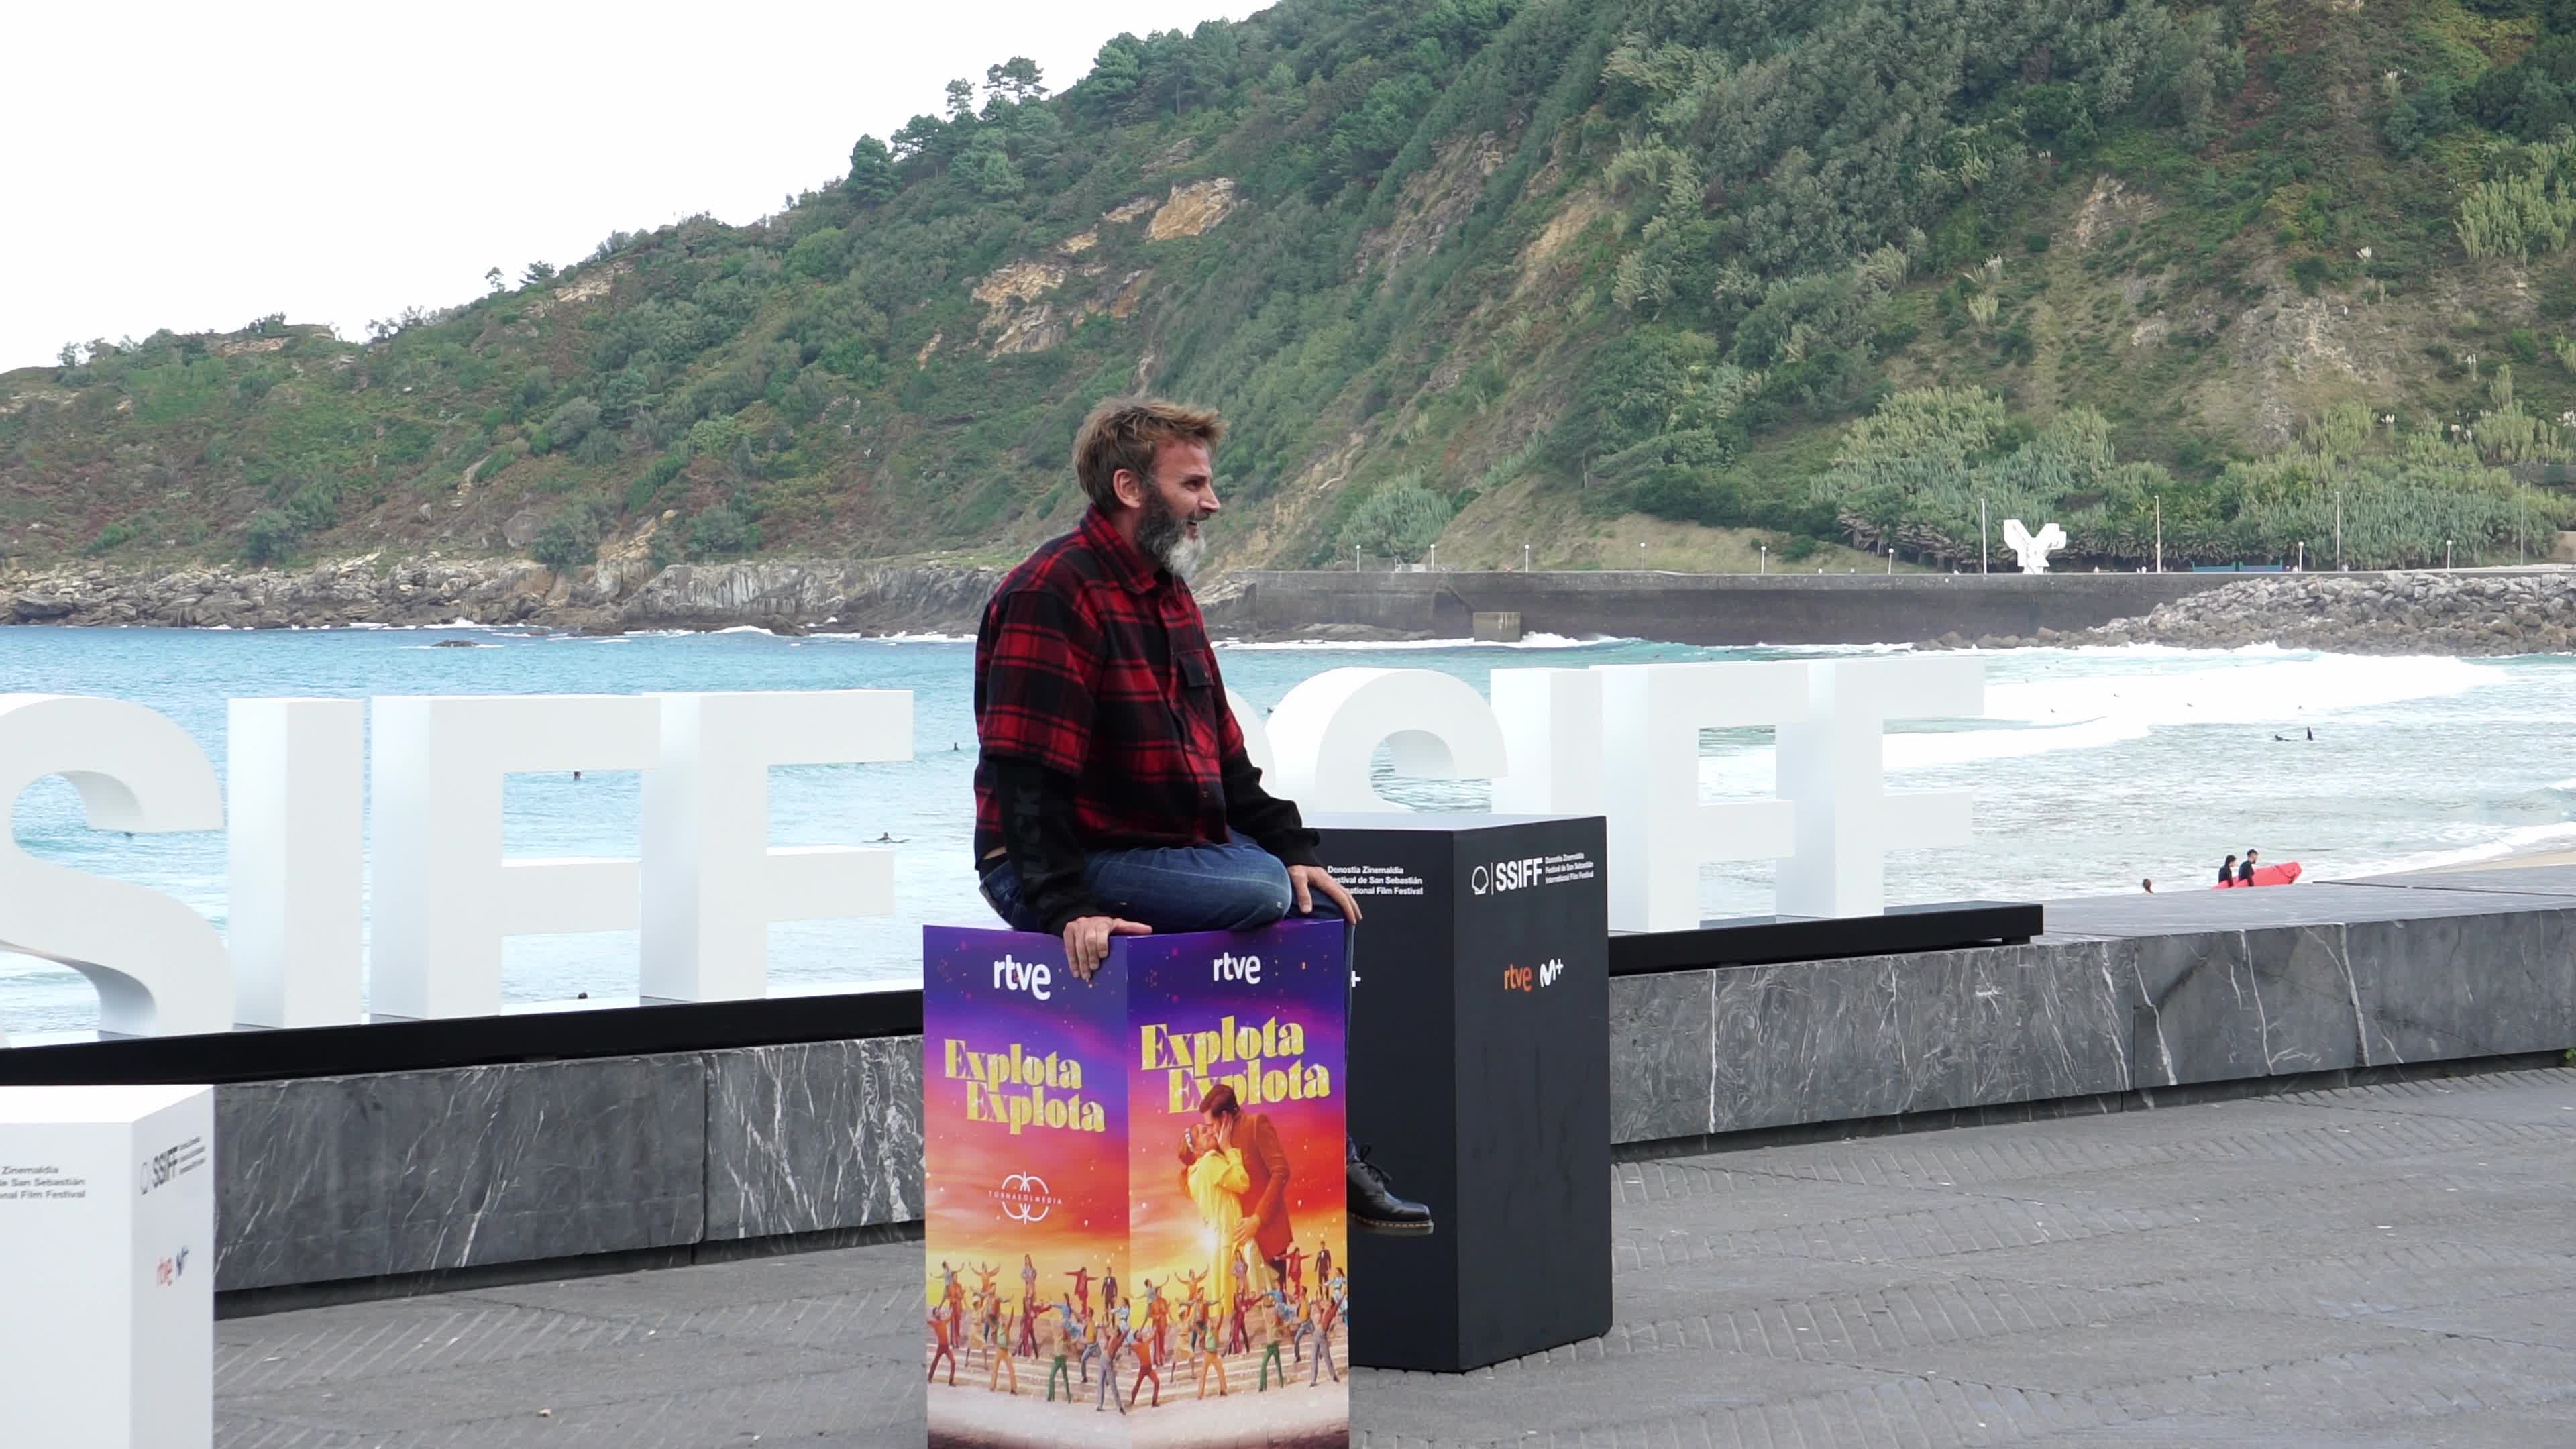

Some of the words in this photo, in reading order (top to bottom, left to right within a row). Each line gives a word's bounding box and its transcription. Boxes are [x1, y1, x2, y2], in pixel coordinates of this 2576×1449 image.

[1327, 865, 1361, 874] Donostia
[1362, 865, 1404, 874] Zinemaldia
[1358, 876, 1367, 884] de
[1369, 876, 1384, 884] San
[1385, 876, 1423, 885] Sebastián
[1496, 857, 1542, 892] SSIFF
[1376, 886, 1393, 895] Film
[1394, 887, 1423, 895] Festival
[994, 954, 1051, 1000] rtve
[1213, 951, 1261, 985] rtve
[1504, 963, 1533, 992] rtve
[1140, 1015, 1304, 1077] Explota
[945, 1038, 1083, 1093] Explota
[966, 1081, 1106, 1135] Explota
